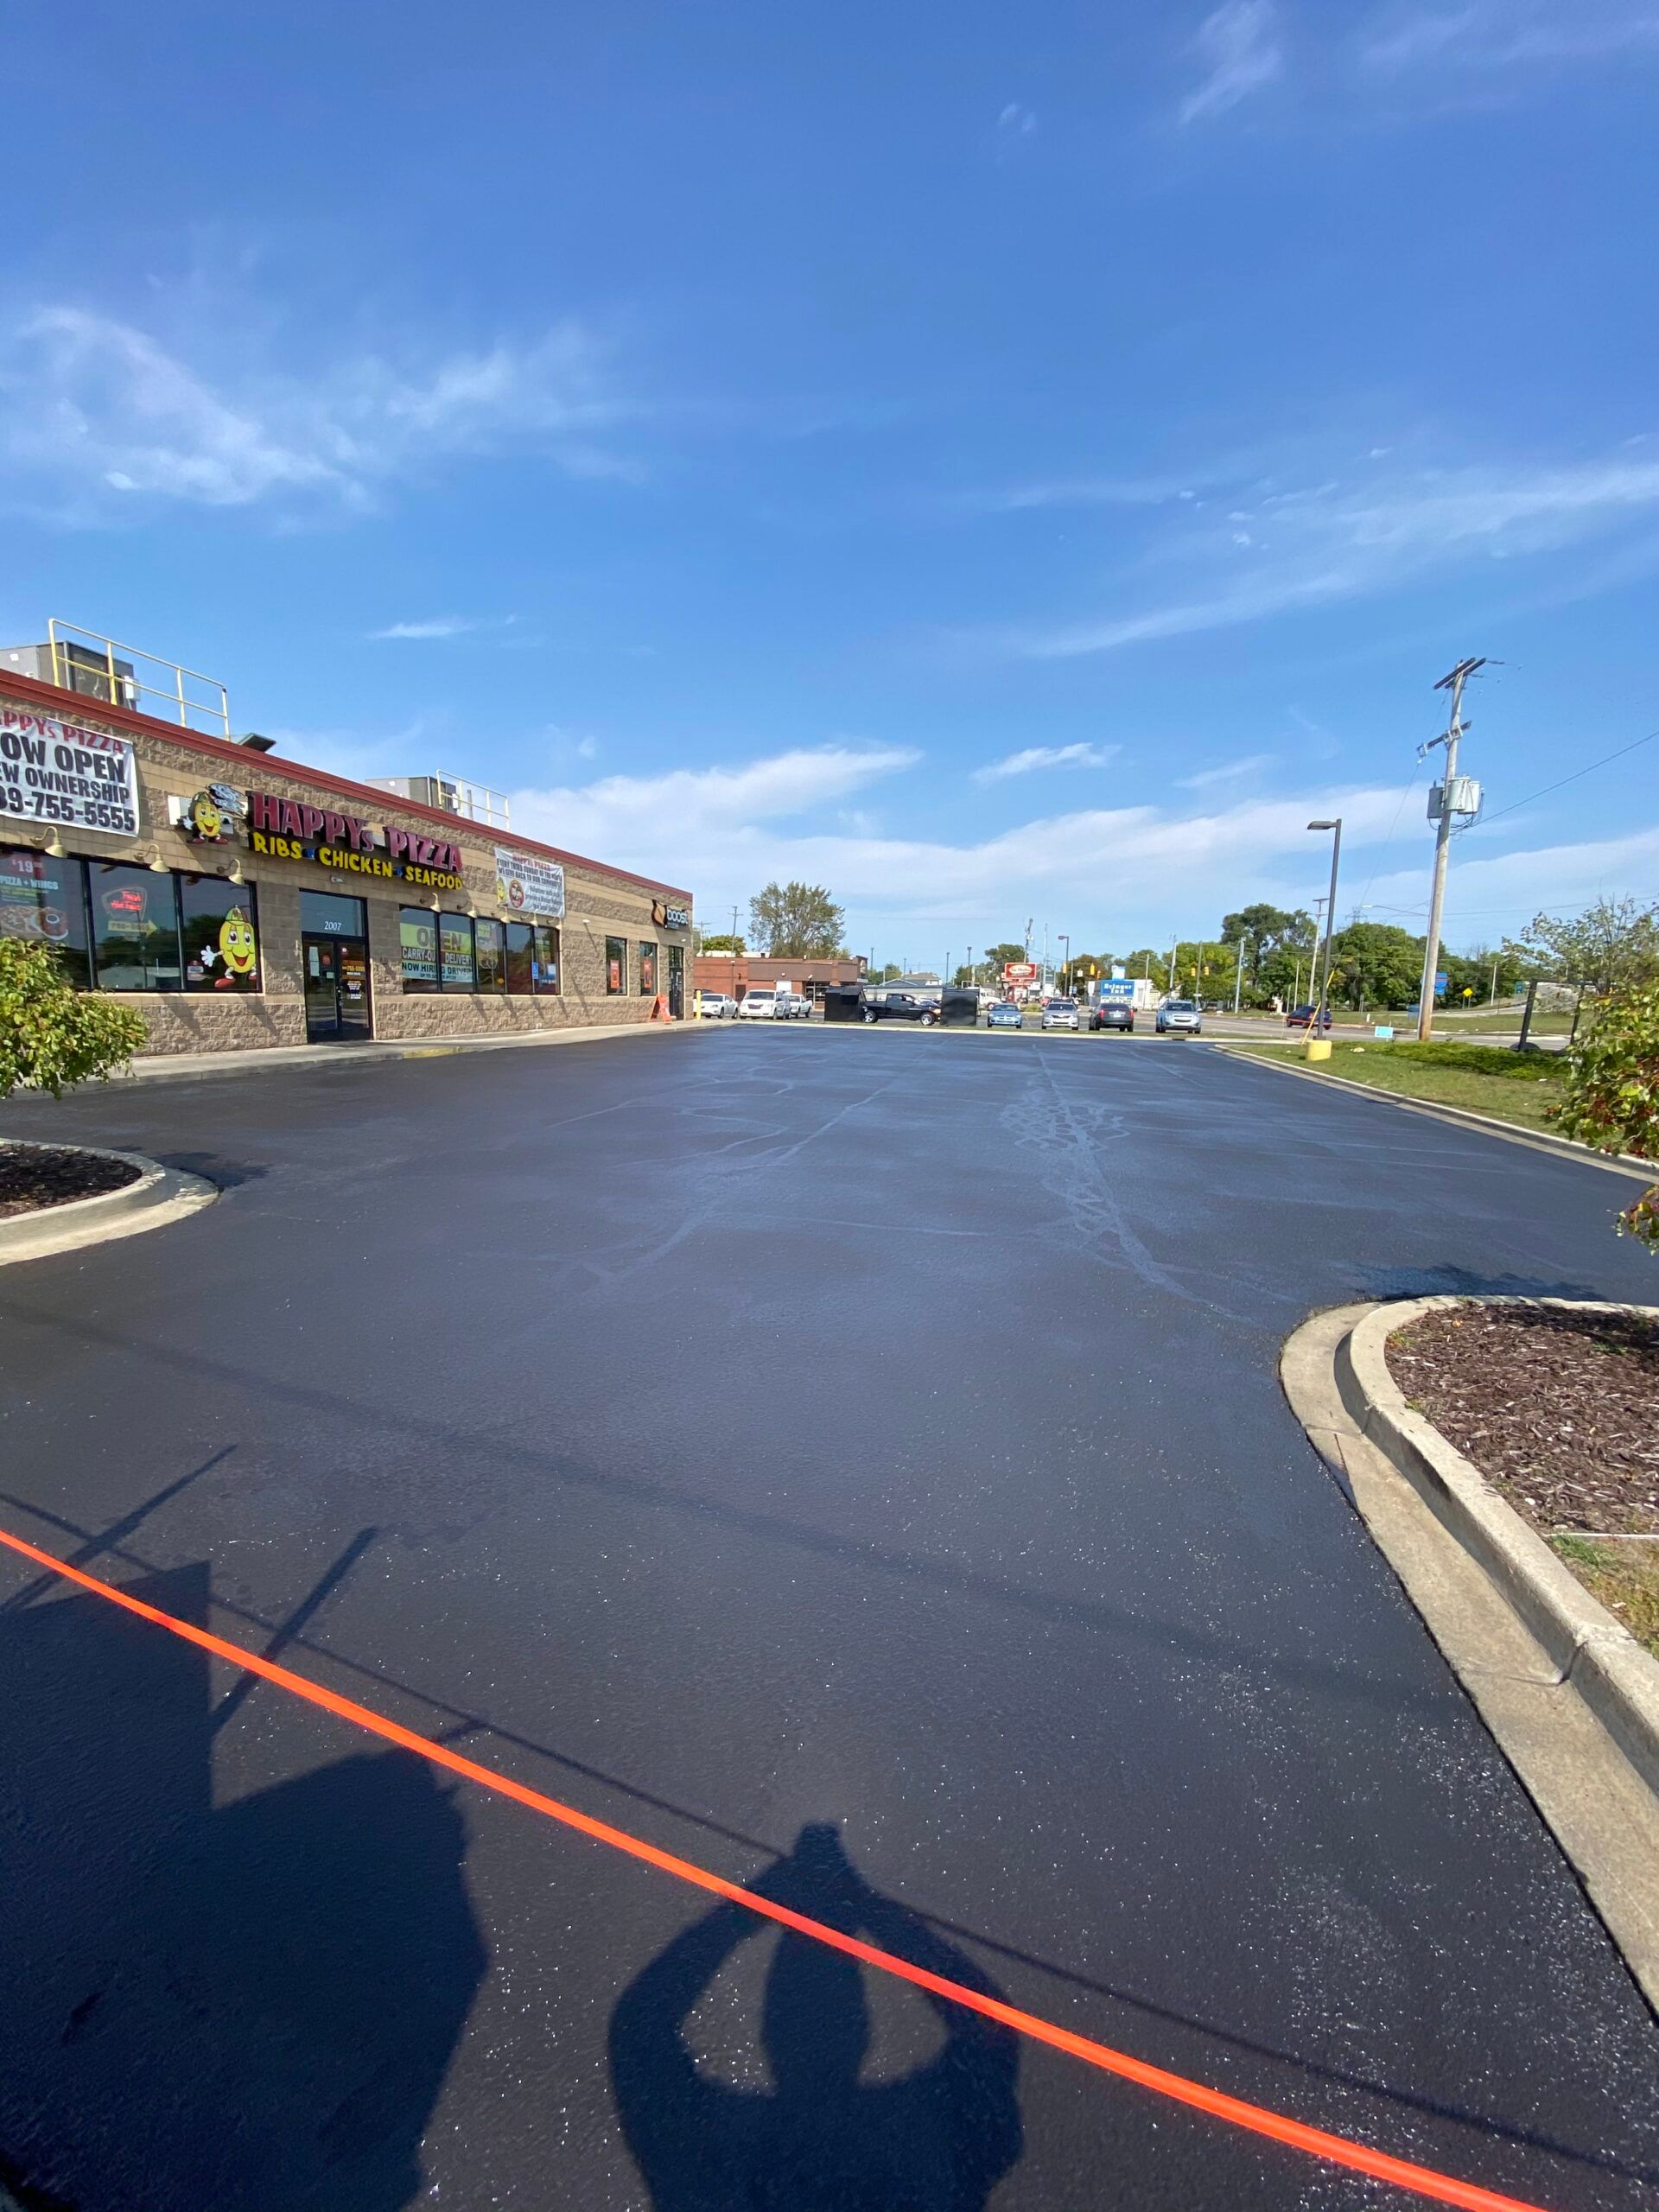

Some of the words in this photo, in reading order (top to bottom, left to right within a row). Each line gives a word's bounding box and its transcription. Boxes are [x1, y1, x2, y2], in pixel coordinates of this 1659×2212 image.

[54, 745, 125, 784] OPEN
[25, 767, 130, 804] OWNERSHIP
[252, 832, 302, 859] RIBS
[320, 848, 393, 878] CHICKEN
[405, 866, 463, 890] SEAFOOD
[386, 827, 462, 872] PIZZA
[324, 920, 342, 931] 2007
[402, 962, 419, 971] NOW
